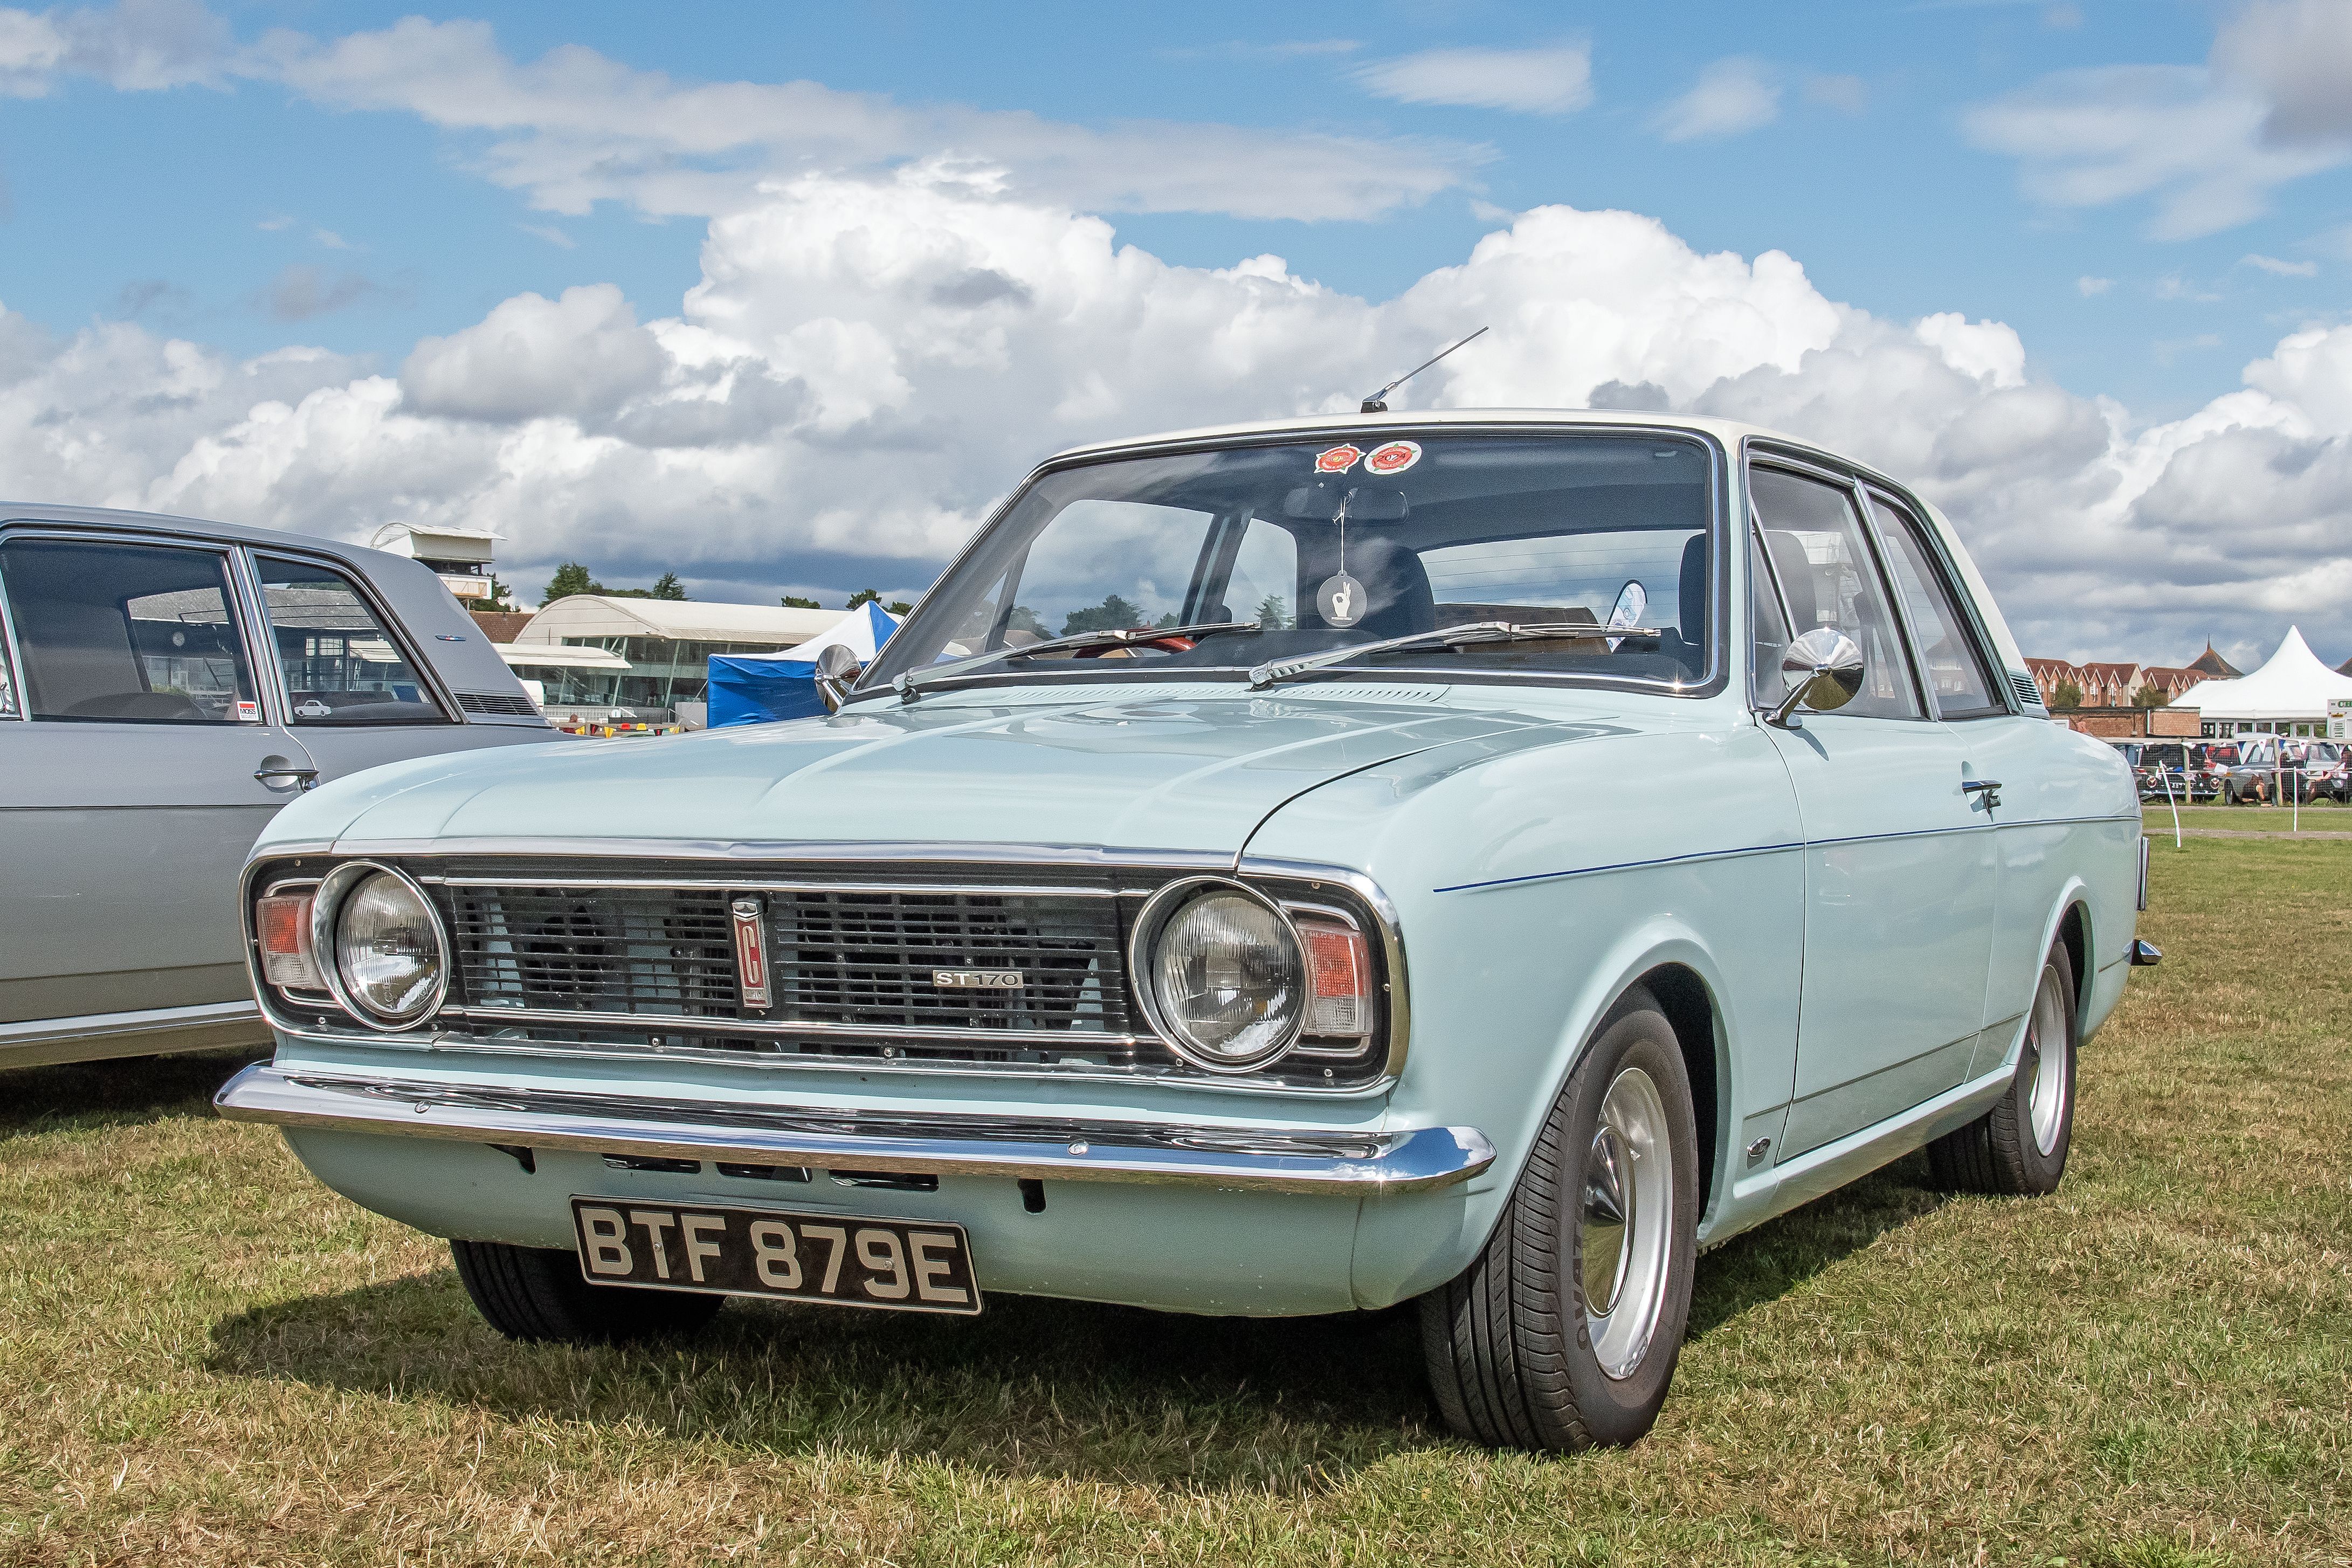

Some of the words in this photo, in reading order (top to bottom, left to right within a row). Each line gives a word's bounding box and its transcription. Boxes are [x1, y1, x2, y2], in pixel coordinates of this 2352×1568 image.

[1376, 453, 1406, 462] 2024
[742, 925, 759, 984] C
[936, 972, 1018, 986] ST170
[580, 1207, 727, 1282] BTF
[750, 1220, 969, 1303] 879E
